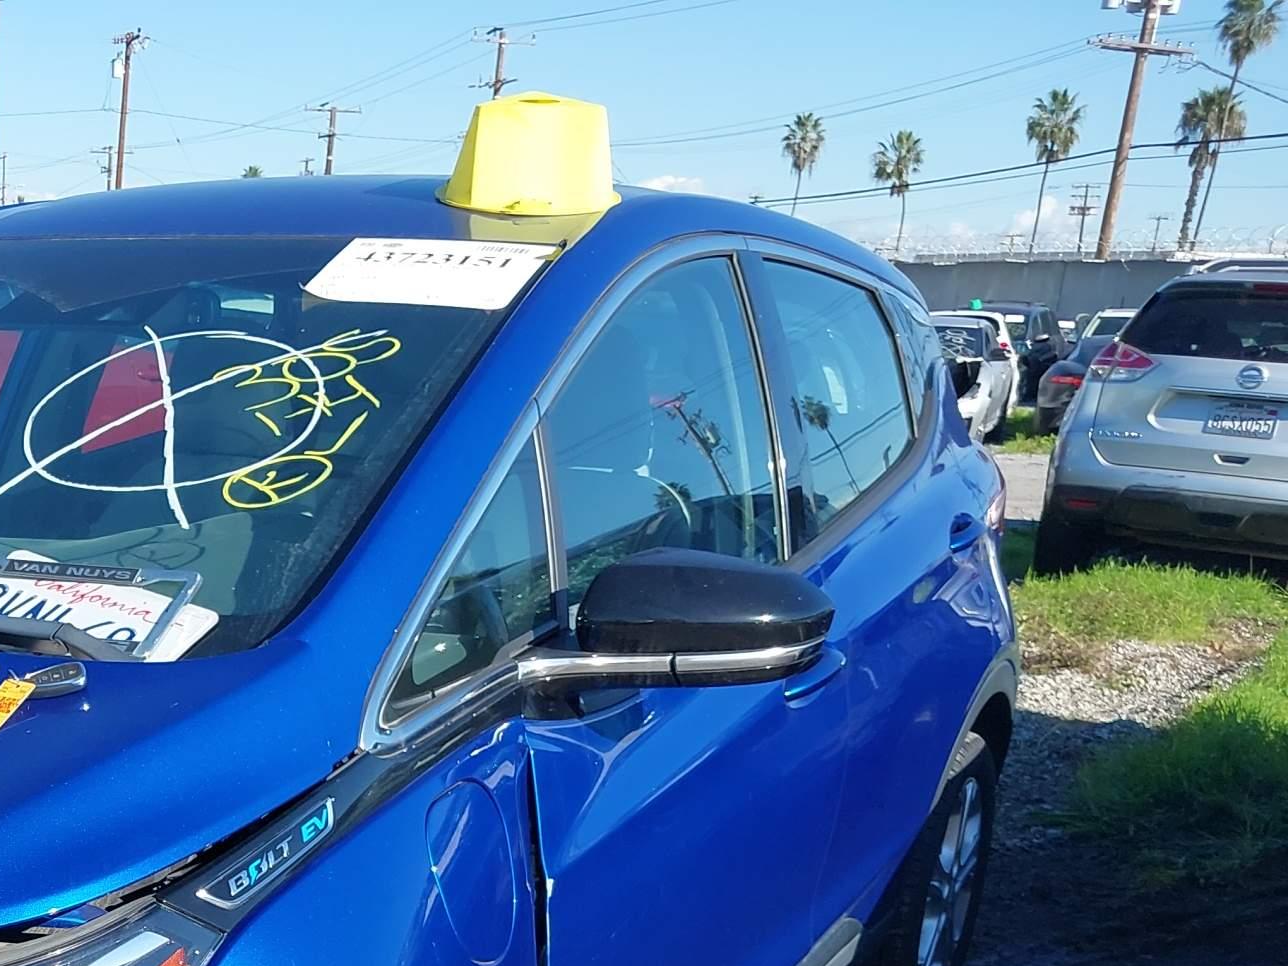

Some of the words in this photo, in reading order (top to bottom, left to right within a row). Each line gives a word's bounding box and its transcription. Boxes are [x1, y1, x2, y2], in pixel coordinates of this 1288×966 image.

[356, 251, 513, 268] 43723151
[11, 560, 60, 576] VAN
[66, 566, 132, 581] NUYS
[299, 808, 328, 844] EV
